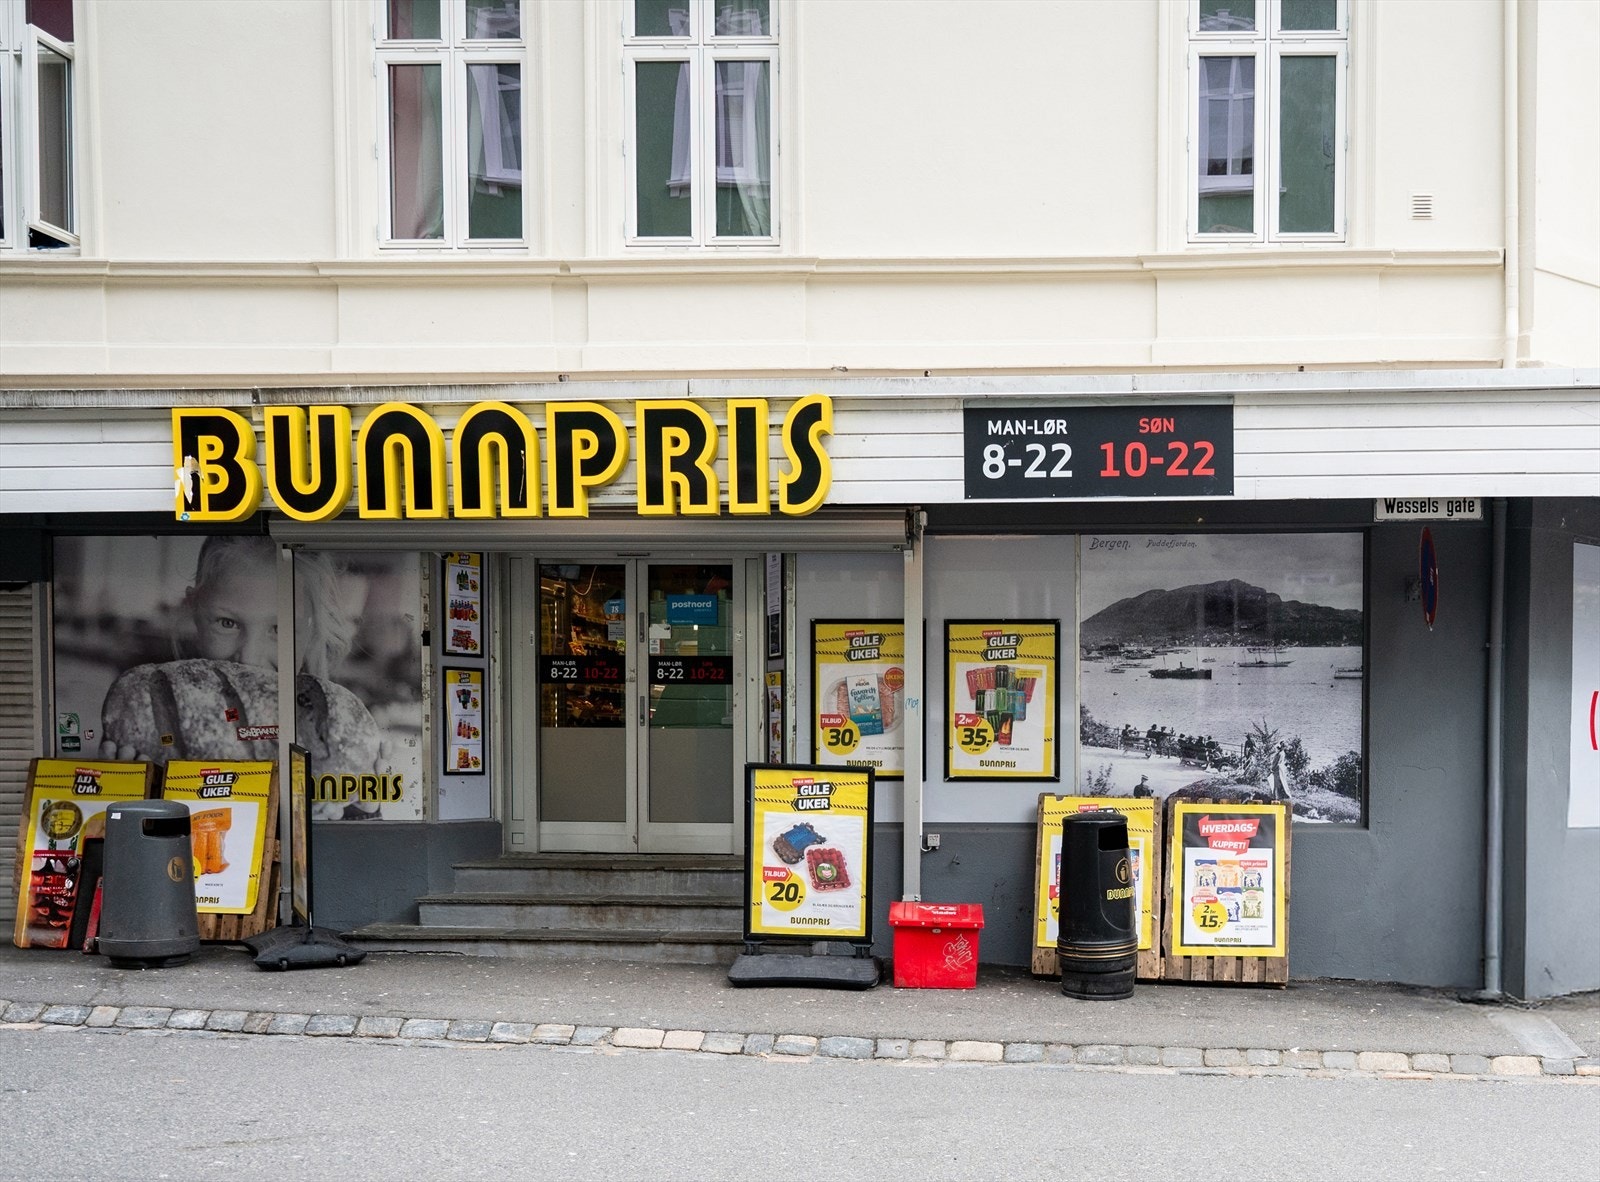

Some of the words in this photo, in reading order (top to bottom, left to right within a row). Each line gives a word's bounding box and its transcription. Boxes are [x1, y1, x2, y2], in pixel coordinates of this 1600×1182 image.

[987, 419, 1068, 436] MAN-LØR
[1138, 417, 1175, 434] SØN
[171, 394, 834, 522] BUNNPRIS
[982, 443, 1073, 480] 8-22
[1099, 440, 1216, 478] 10-22
[1383, 497, 1439, 514] Wessels
[1446, 497, 1475, 517] gate
[1088, 537, 1131, 550] Bergen.
[671, 600, 712, 610] postnord
[852, 635, 880, 647] GULE
[989, 635, 1017, 647] GULE
[850, 648, 879, 660] UKER
[987, 648, 1016, 660] UKER
[551, 667, 577, 678] 8-22
[584, 667, 618, 678] 10-22
[657, 668, 684, 679] 8-22
[690, 668, 724, 679] 10-22
[979, 760, 1017, 768] BUNNPRIS
[205, 774, 233, 785] GULE
[202, 786, 230, 798] UKER
[800, 784, 830, 796] GULE
[798, 798, 829, 810] UKER
[1201, 822, 1257, 834] HVERDAGS-
[764, 870, 786, 878] TILBUD
[790, 916, 831, 926] BUNNPRIS
